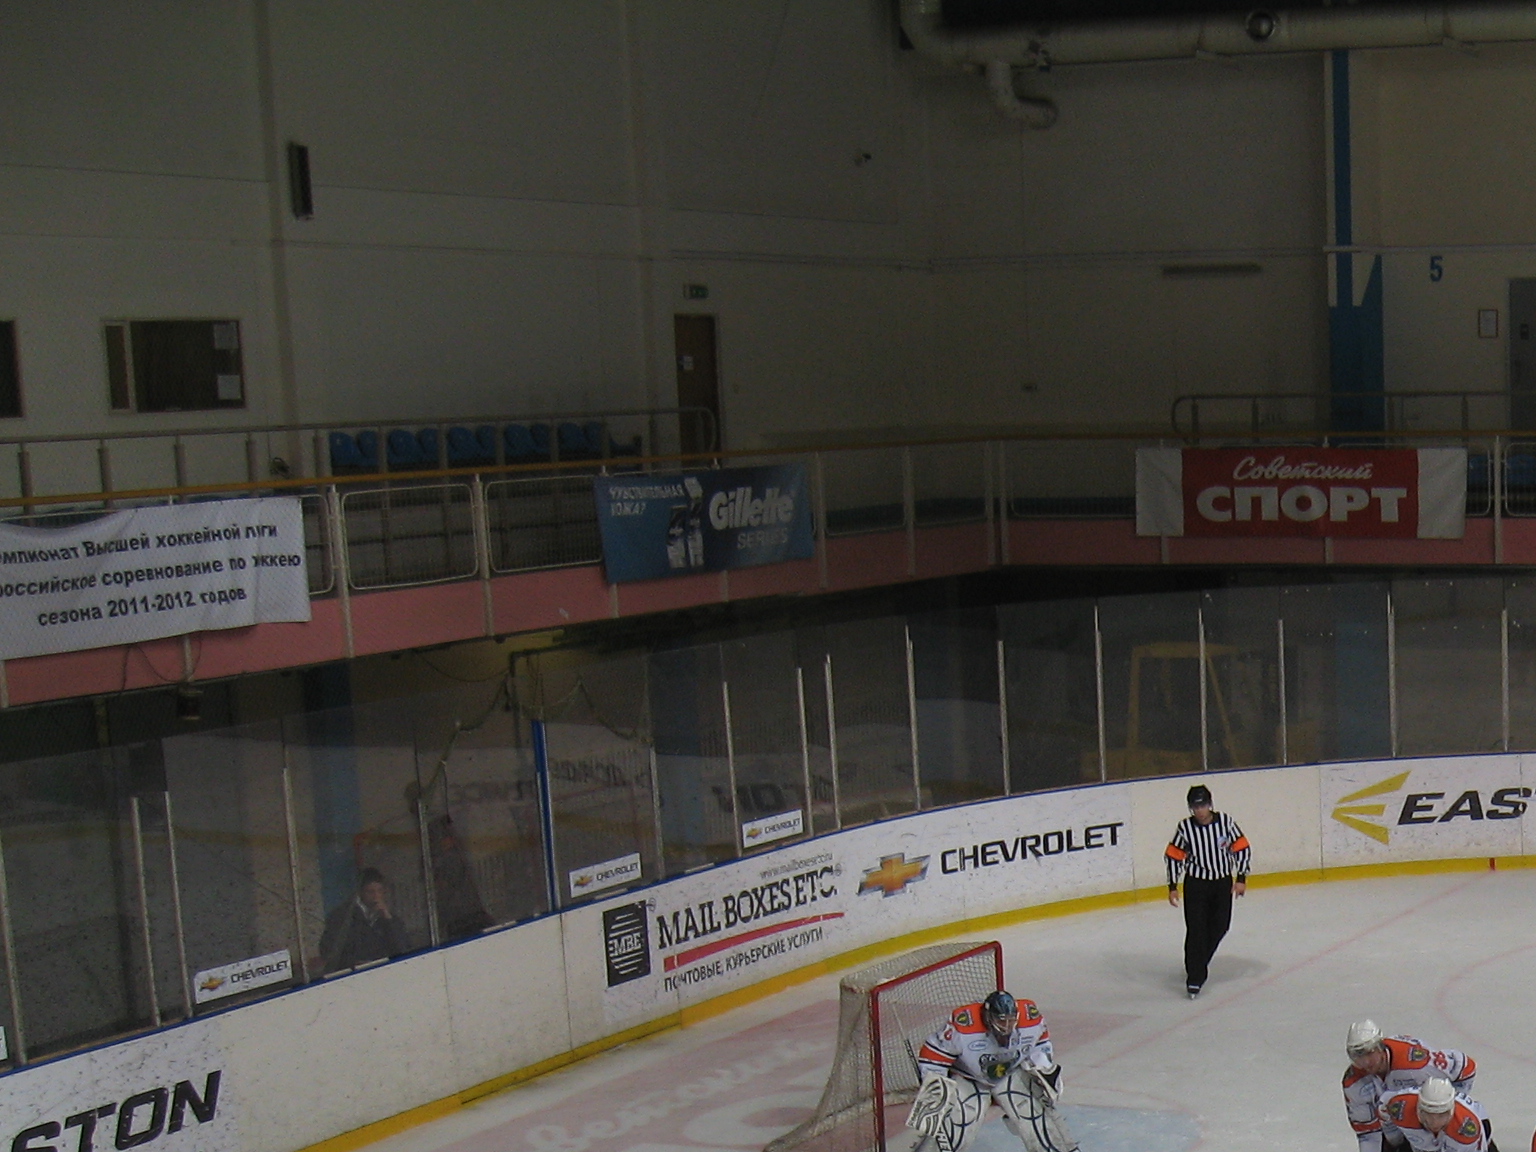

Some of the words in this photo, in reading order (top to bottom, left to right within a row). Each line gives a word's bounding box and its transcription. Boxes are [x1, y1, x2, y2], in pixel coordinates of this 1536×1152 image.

[1429, 255, 1444, 282] 5
[1232, 456, 1374, 481] Советский
[709, 485, 794, 530] Gillette
[1196, 485, 1408, 522] СПОРТ
[0, 545, 80, 566] мпионат
[83, 532, 151, 559] Высшей
[156, 523, 240, 548] хоккейной
[736, 527, 789, 550] SERIES
[102, 557, 223, 588] соревнование
[229, 556, 247, 571] по
[38, 605, 103, 627] сезона
[107, 590, 197, 619] 2011-2012
[200, 587, 248, 602] годов
[763, 817, 801, 834] CHEVROLET
[940, 822, 1124, 875] CHEVROLET
[596, 861, 639, 882] CHEVROLET
[656, 900, 722, 949] MAIL
[721, 877, 792, 931] BOXES
[725, 940, 786, 971] КУРЬЕРСКИЕ
[786, 926, 823, 953] УСЛУГИ
[230, 959, 289, 984] CHEVROLET
